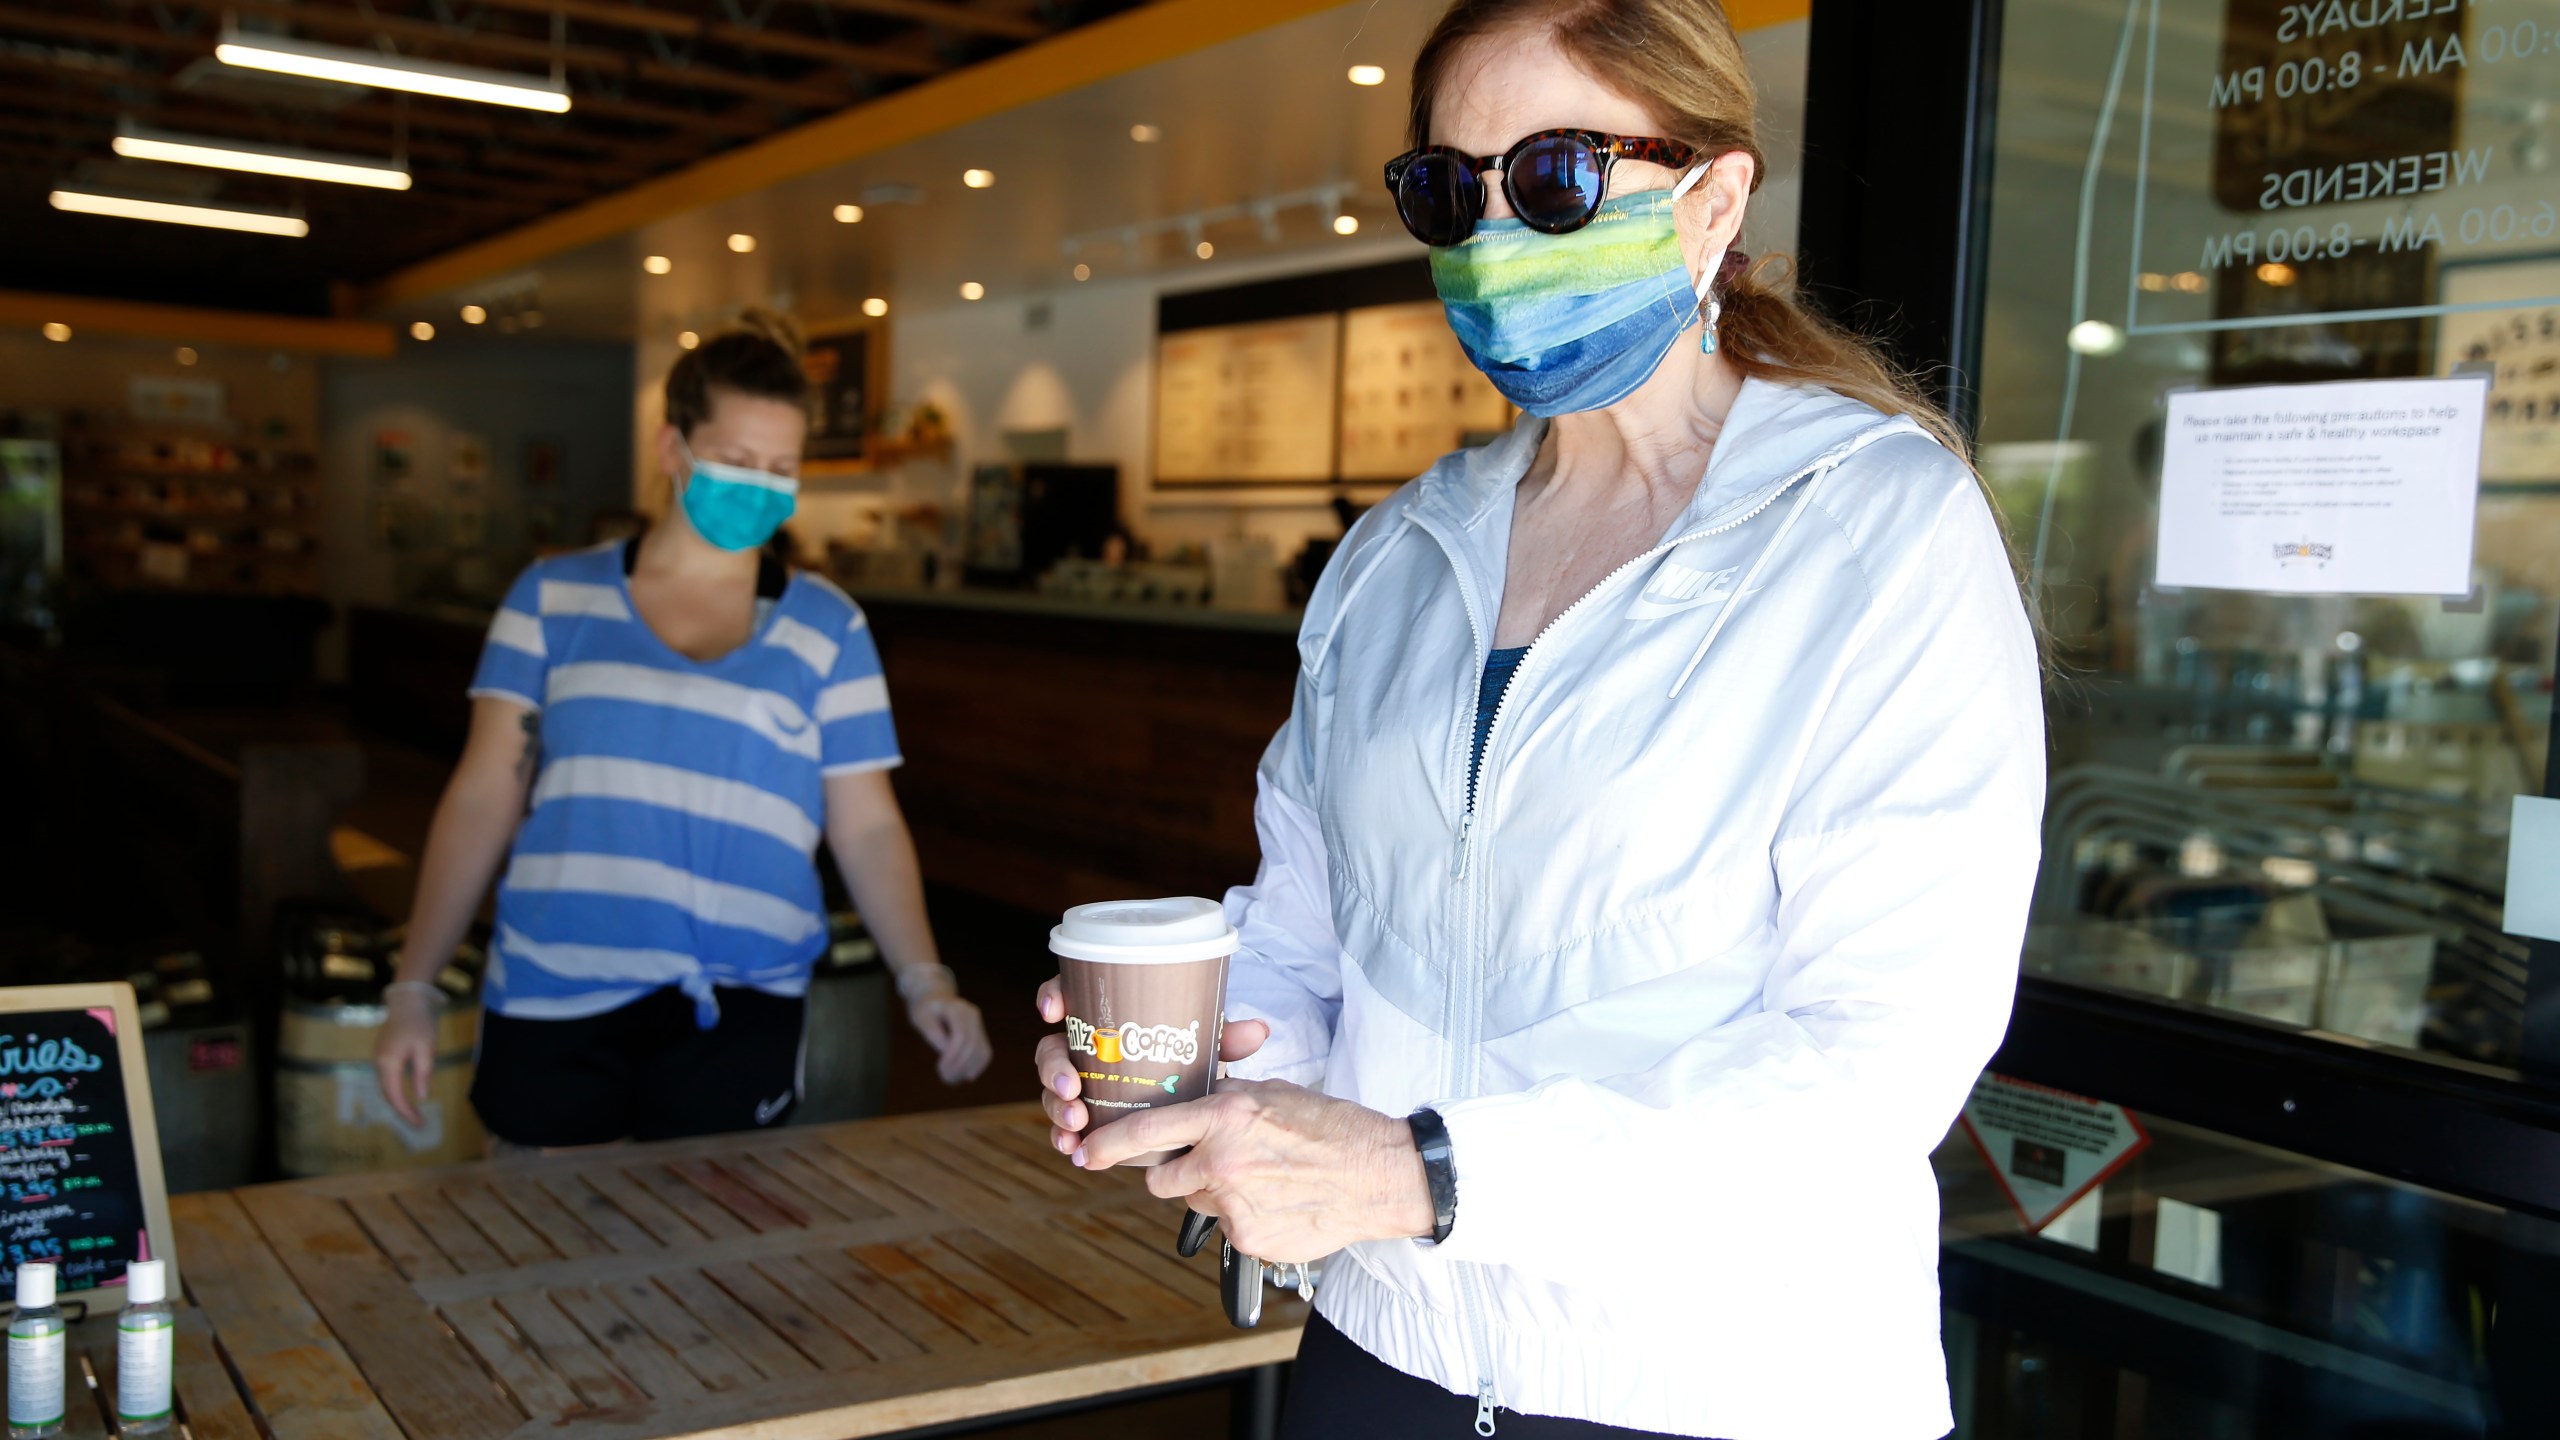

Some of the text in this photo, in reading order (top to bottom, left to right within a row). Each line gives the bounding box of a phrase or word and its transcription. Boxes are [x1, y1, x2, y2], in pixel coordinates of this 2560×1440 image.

[2183, 413, 2220, 427] Please
[2250, 411, 2269, 425] the
[2273, 410, 2327, 426] following
[2330, 408, 2407, 425] precautions
[2411, 408, 2425, 420] to
[2429, 406, 2458, 421] help
[2212, 428, 2261, 443] maintain
[2277, 427, 2302, 441] safe
[2307, 427, 2316, 440] &
[2319, 426, 2366, 442] healthy
[2370, 425, 2441, 439] workspace
[1646, 563, 1740, 599] NIKE
[1119, 1020, 1200, 1065] Coffee
[1089, 1072, 1105, 1080] CUP
[1132, 1077, 1157, 1086] TIME
